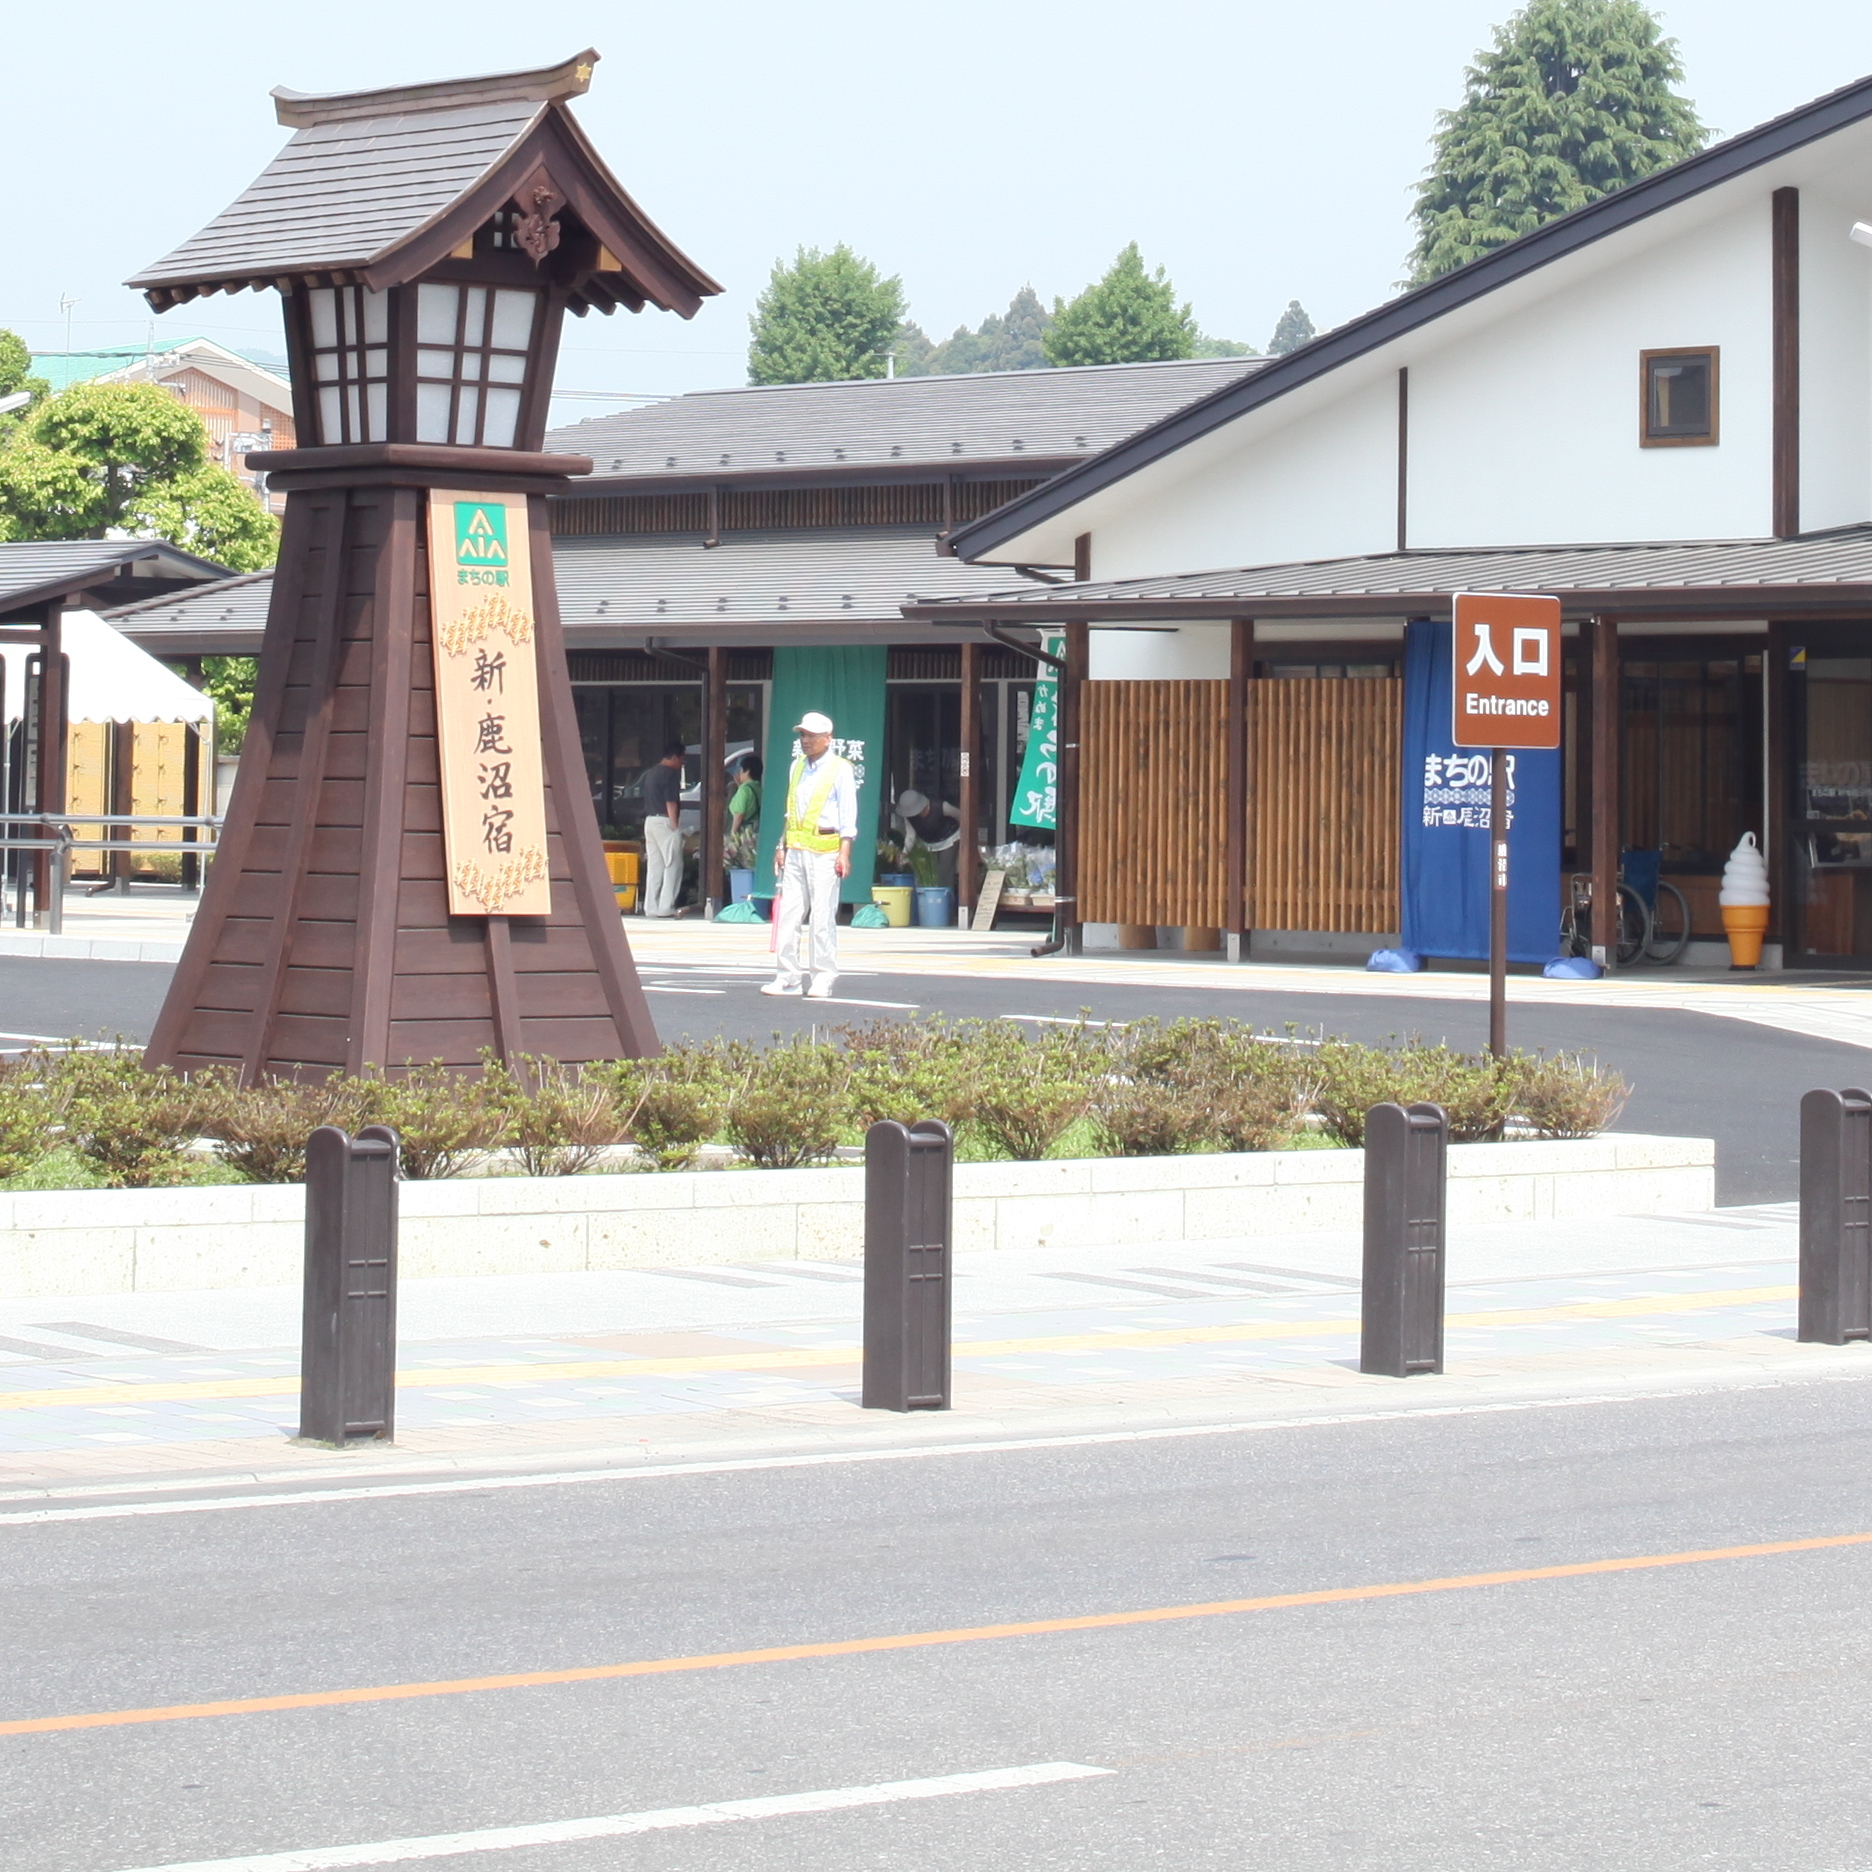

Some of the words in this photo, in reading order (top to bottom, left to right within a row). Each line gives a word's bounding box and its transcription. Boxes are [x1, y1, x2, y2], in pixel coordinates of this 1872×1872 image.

[457, 569, 510, 587] まちの駅
[1465, 623, 1549, 677] 入口
[1465, 693, 1550, 716] Entrance
[791, 738, 865, 761] 新野菜
